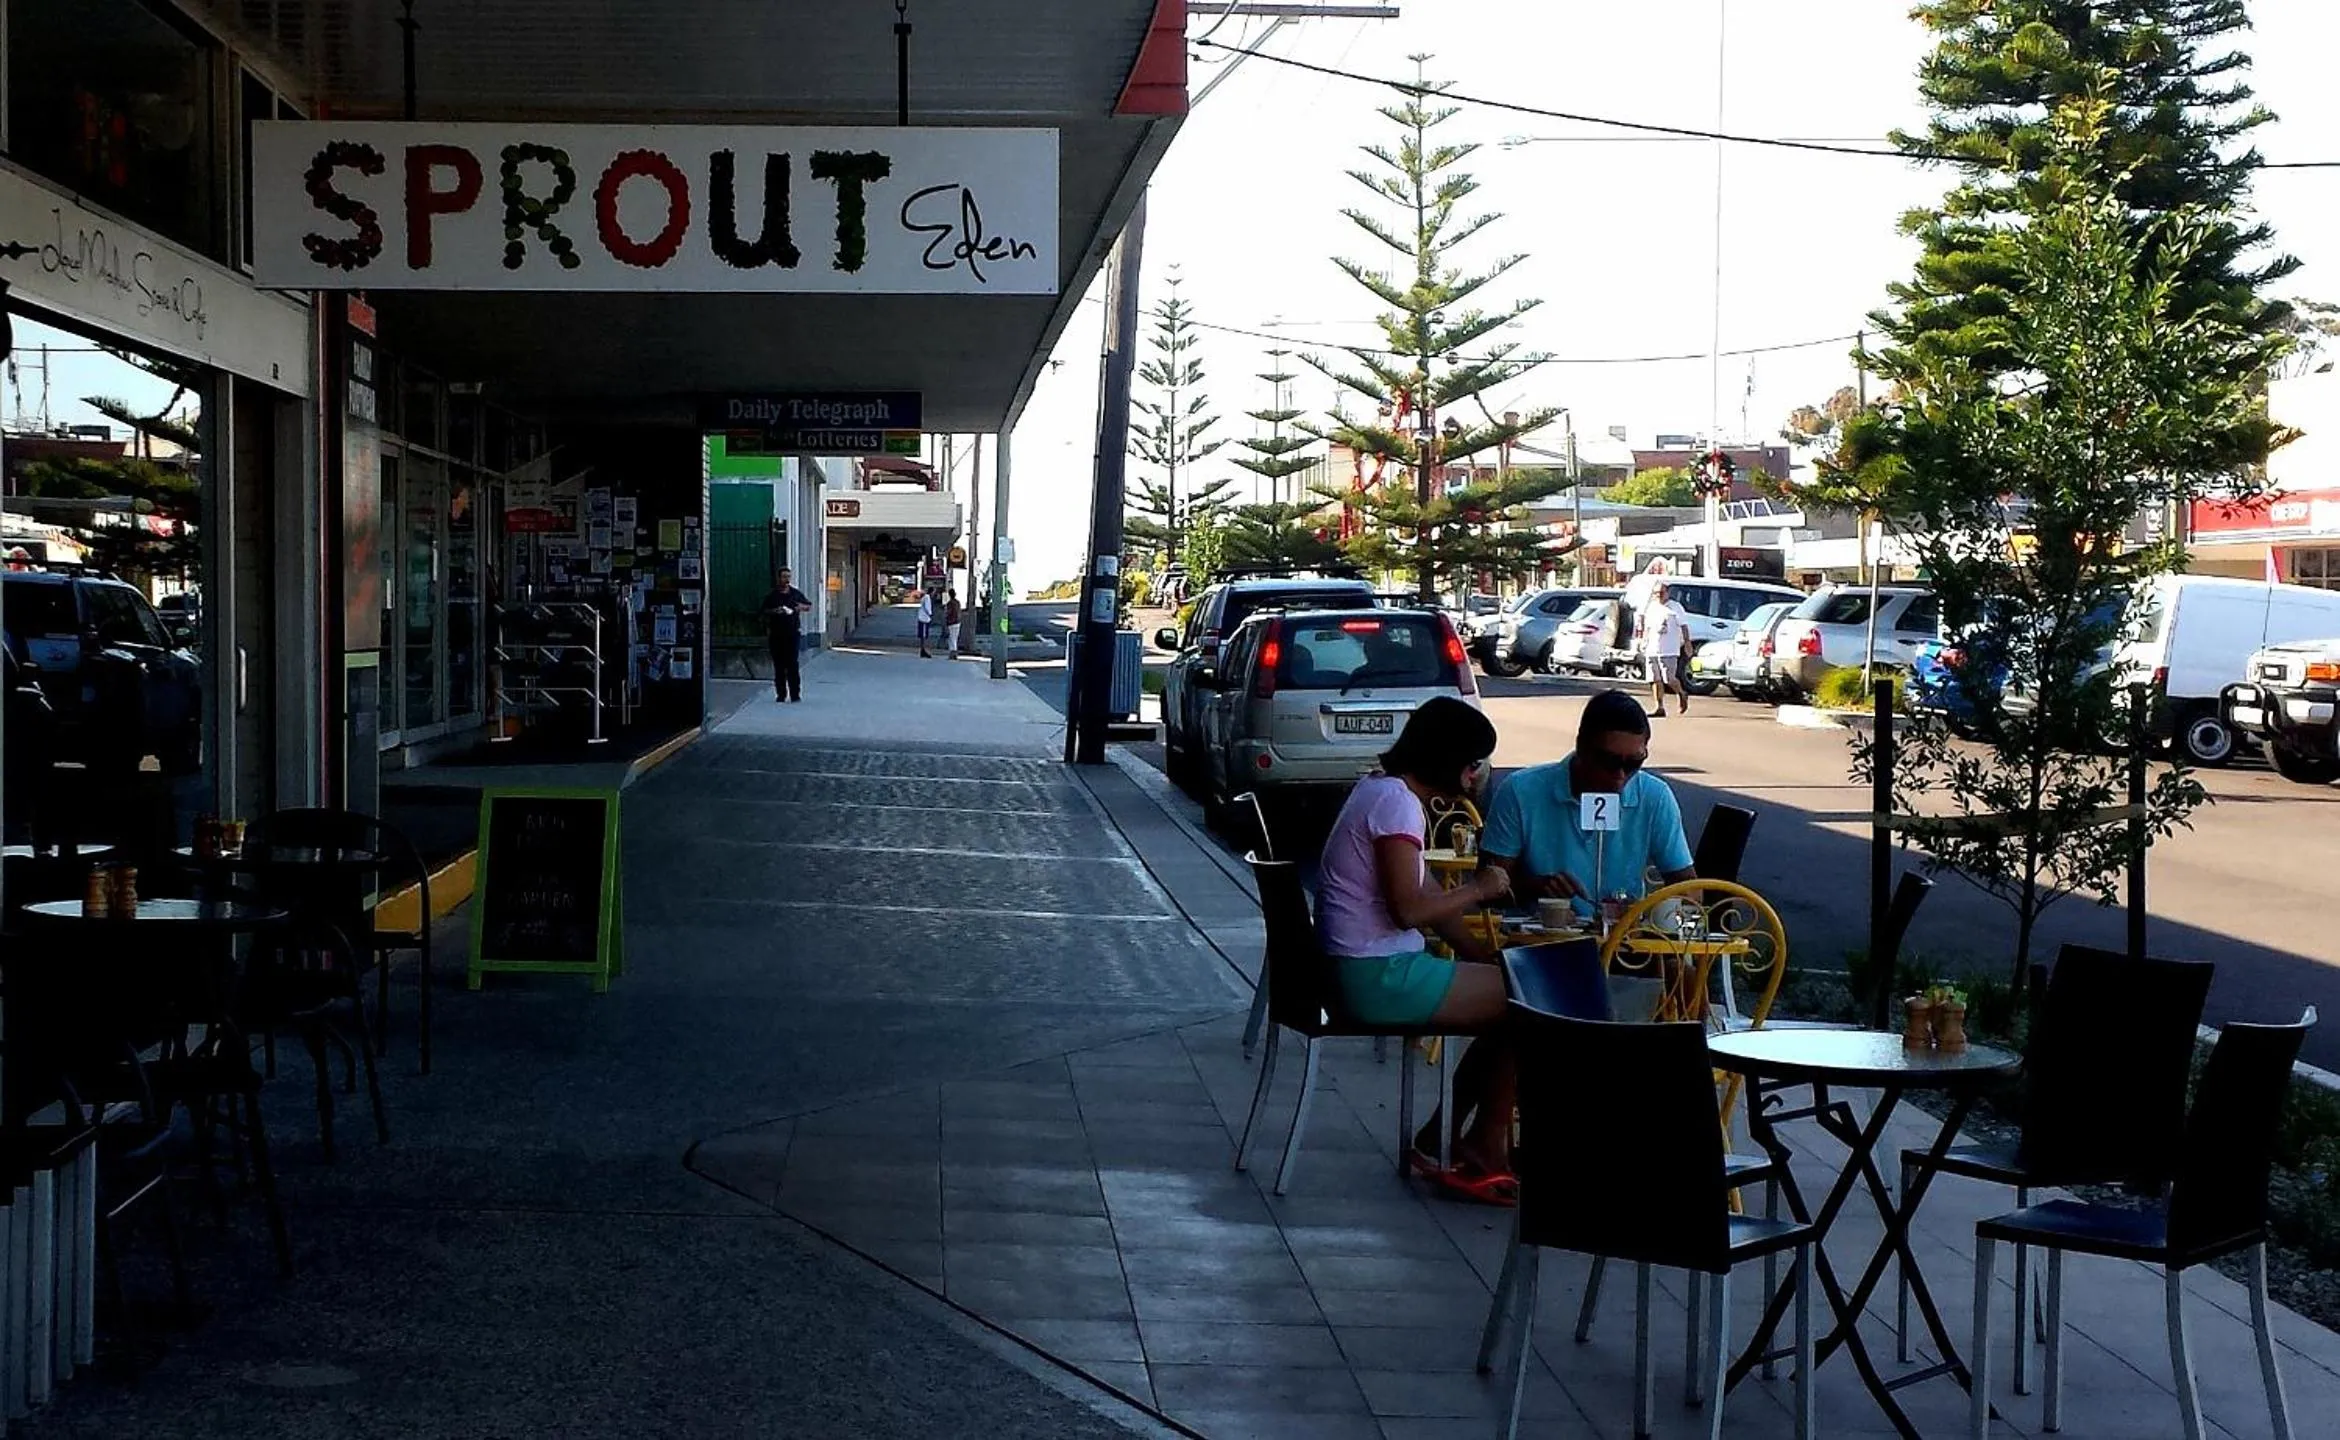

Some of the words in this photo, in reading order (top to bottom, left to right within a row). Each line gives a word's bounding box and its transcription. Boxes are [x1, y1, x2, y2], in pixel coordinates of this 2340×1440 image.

[302, 140, 892, 274] SPROUT
[901, 179, 1037, 283] Eden
[727, 399, 781, 425] Daily
[788, 399, 890, 425] Telegraph
[797, 431, 878, 448] Lotteries
[1594, 797, 1606, 820] 2
